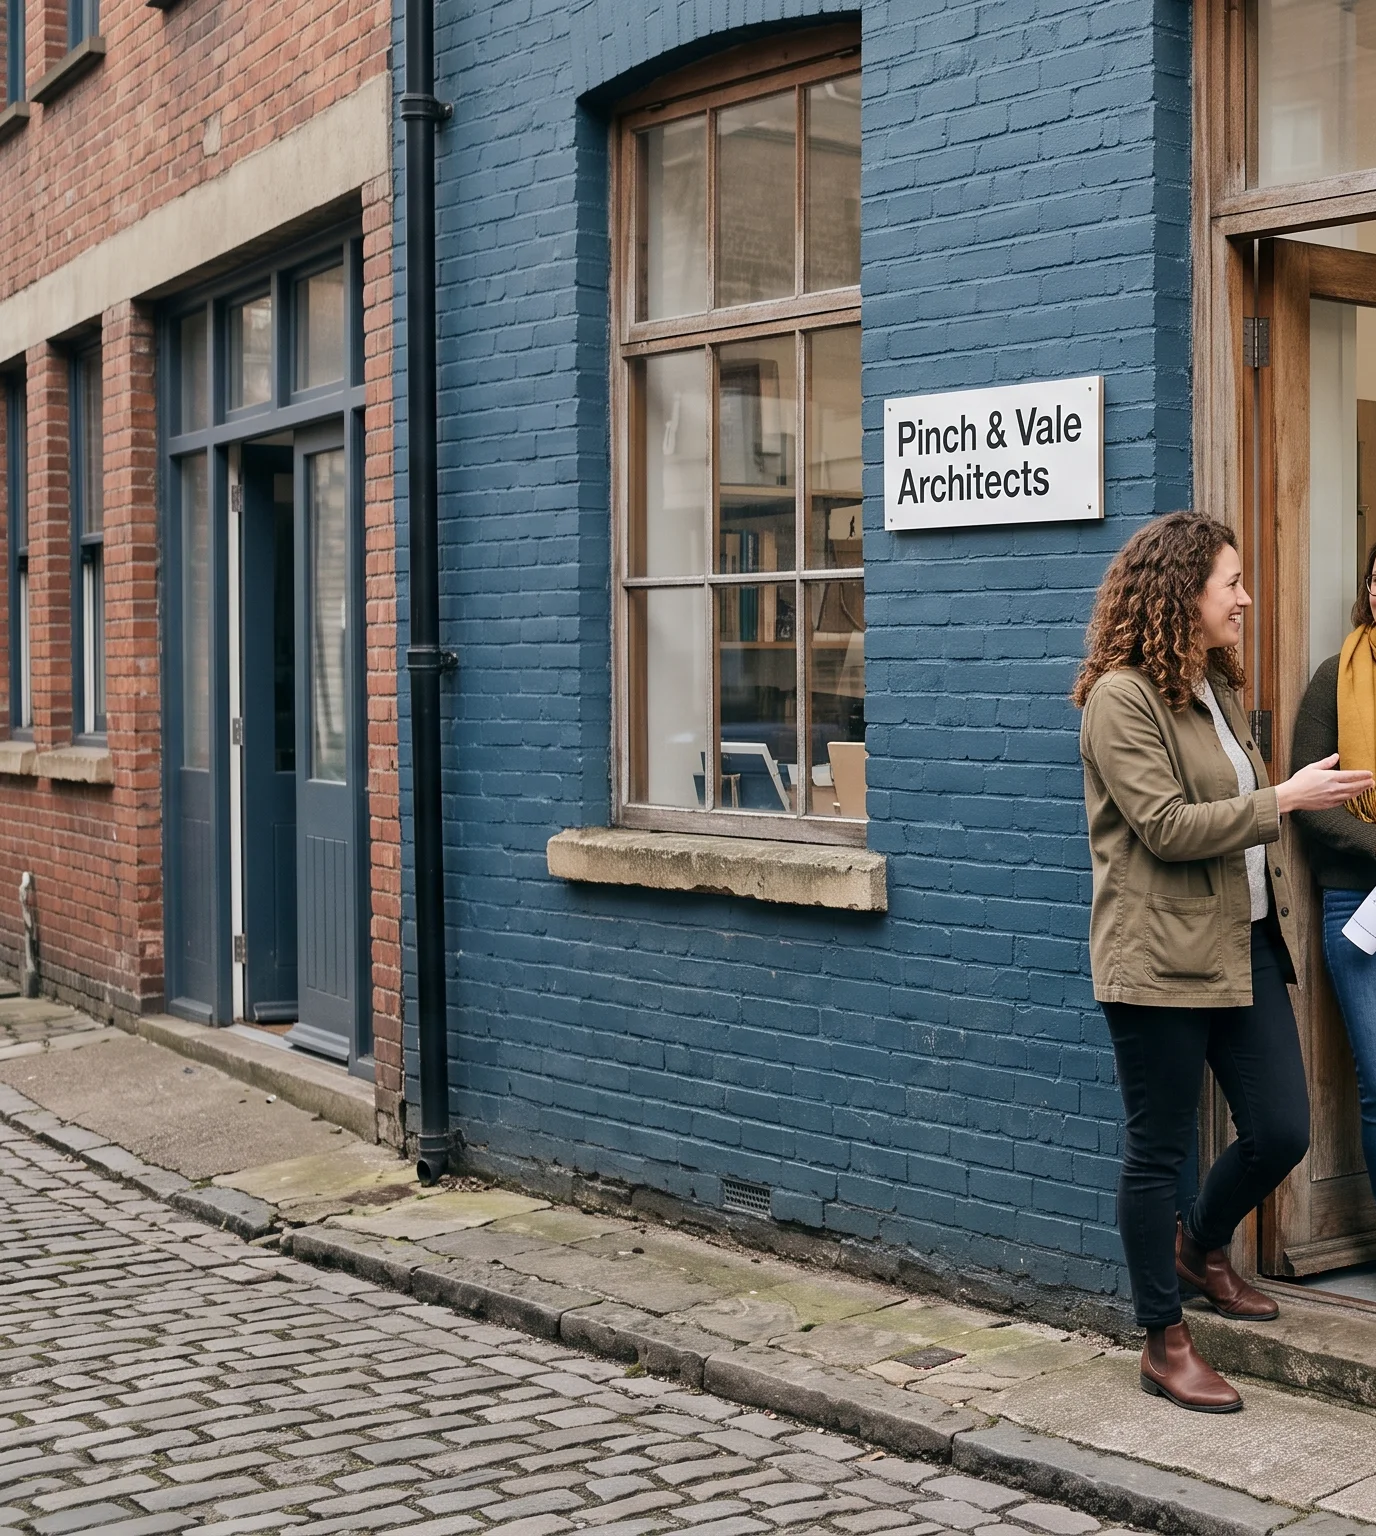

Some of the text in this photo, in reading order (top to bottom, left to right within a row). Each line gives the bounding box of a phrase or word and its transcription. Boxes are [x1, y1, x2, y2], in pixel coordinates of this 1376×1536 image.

[898, 404, 1082, 457] Pinch & Vale
[897, 460, 1050, 505] Architects
